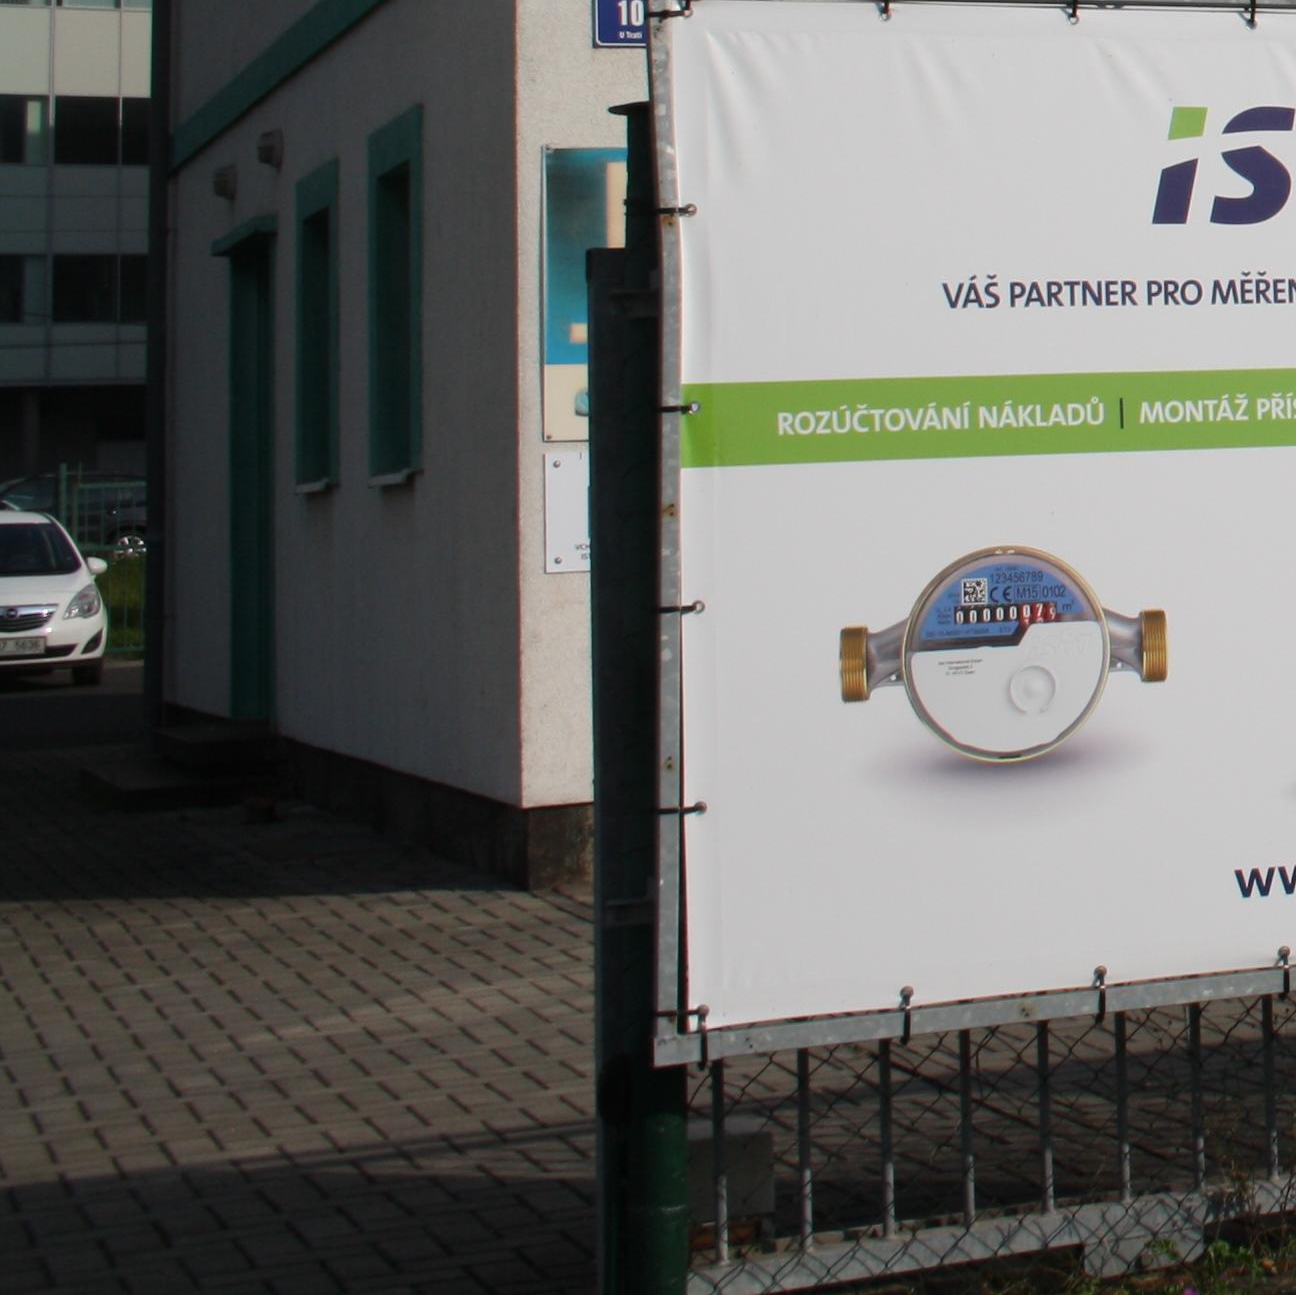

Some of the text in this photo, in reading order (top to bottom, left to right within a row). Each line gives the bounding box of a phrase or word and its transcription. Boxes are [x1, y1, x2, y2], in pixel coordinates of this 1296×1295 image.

[618, 0, 644, 26] 10
[942, 274, 1000, 309] VÁŠ
[1010, 279, 1139, 308] PARTNER
[1147, 279, 1203, 307] PRO
[778, 400, 970, 437] ROZÚČTOVÁNÍ
[979, 396, 1105, 430] NÁKLADŮ
[1139, 392, 1249, 425] MONTÁŽ
